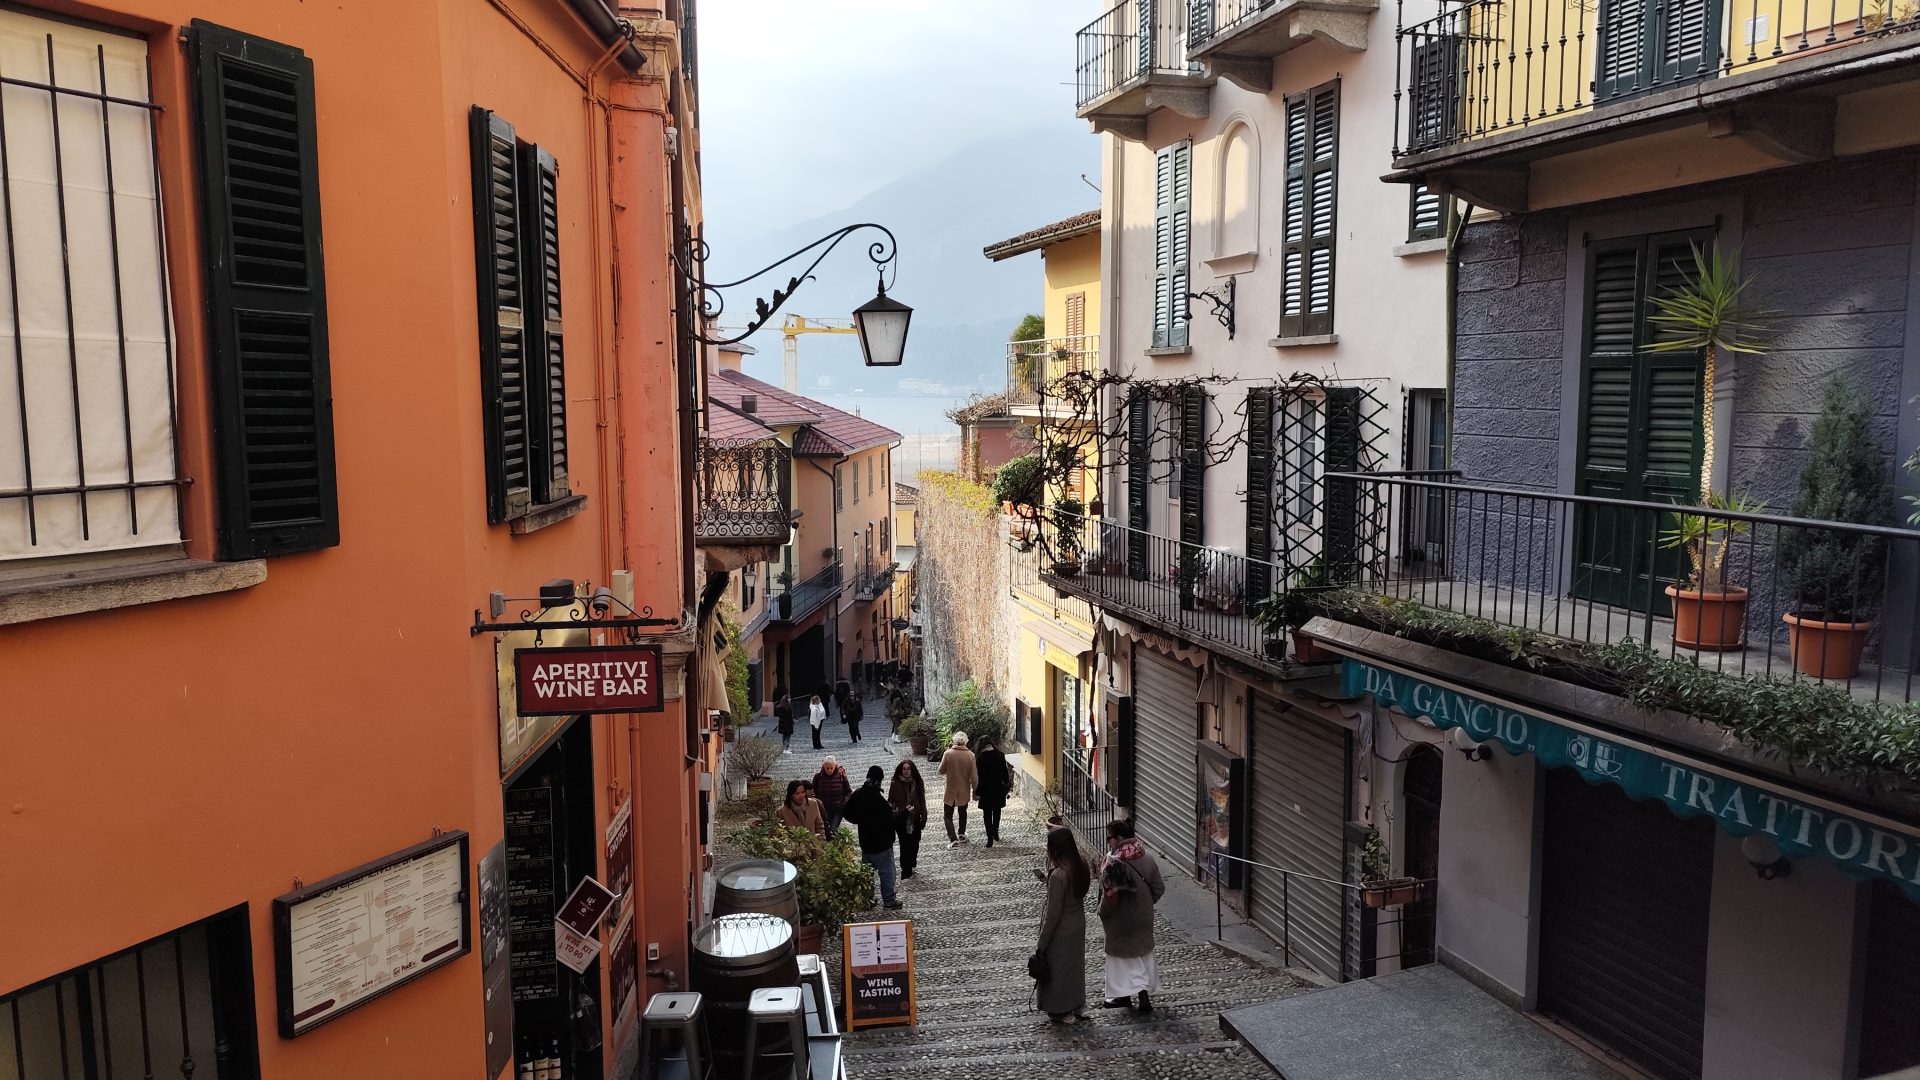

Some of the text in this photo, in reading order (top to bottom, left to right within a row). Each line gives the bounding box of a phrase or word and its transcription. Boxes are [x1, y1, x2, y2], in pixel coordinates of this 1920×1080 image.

[532, 661, 648, 681] APERITIVI
[534, 679, 648, 698] WINE BAR
[564, 943, 583, 960] TO GO
[565, 933, 594, 956] WINE KIT
[867, 977, 894, 987] WINE
[859, 987, 902, 998] TASTING
